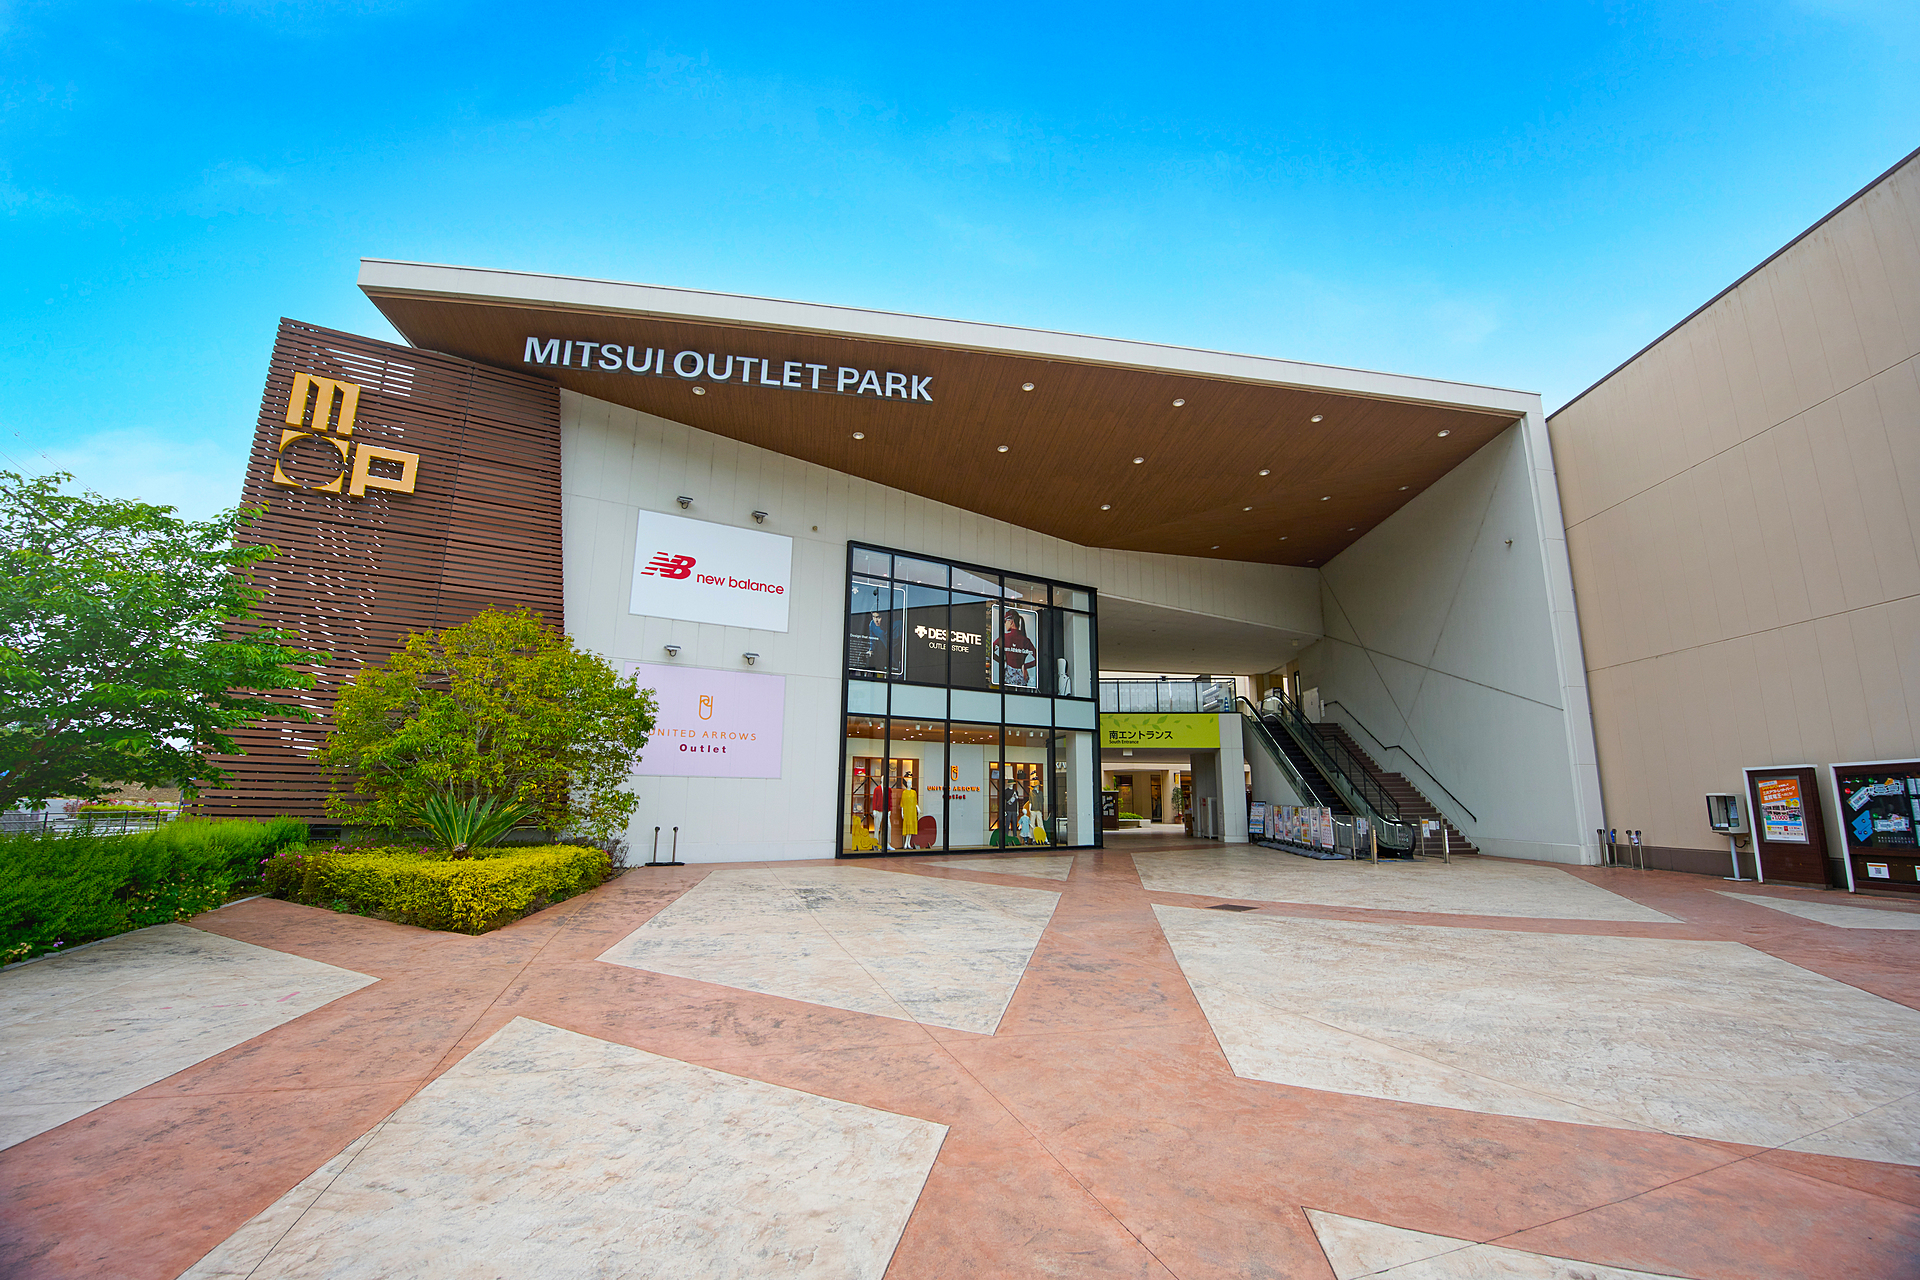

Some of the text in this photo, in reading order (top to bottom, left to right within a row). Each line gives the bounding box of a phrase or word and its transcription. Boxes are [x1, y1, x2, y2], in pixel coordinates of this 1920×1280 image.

[523, 336, 934, 401] MITSUI OUTLET PARK
[696, 573, 726, 586] new
[728, 575, 785, 595] balance
[927, 627, 982, 646] DESCENTE
[928, 641, 970, 654] OUTLE STORE
[648, 728, 757, 741] UNITED ARROWS
[1108, 730, 1174, 740] 南エントランス
[679, 743, 727, 754] Outlet
